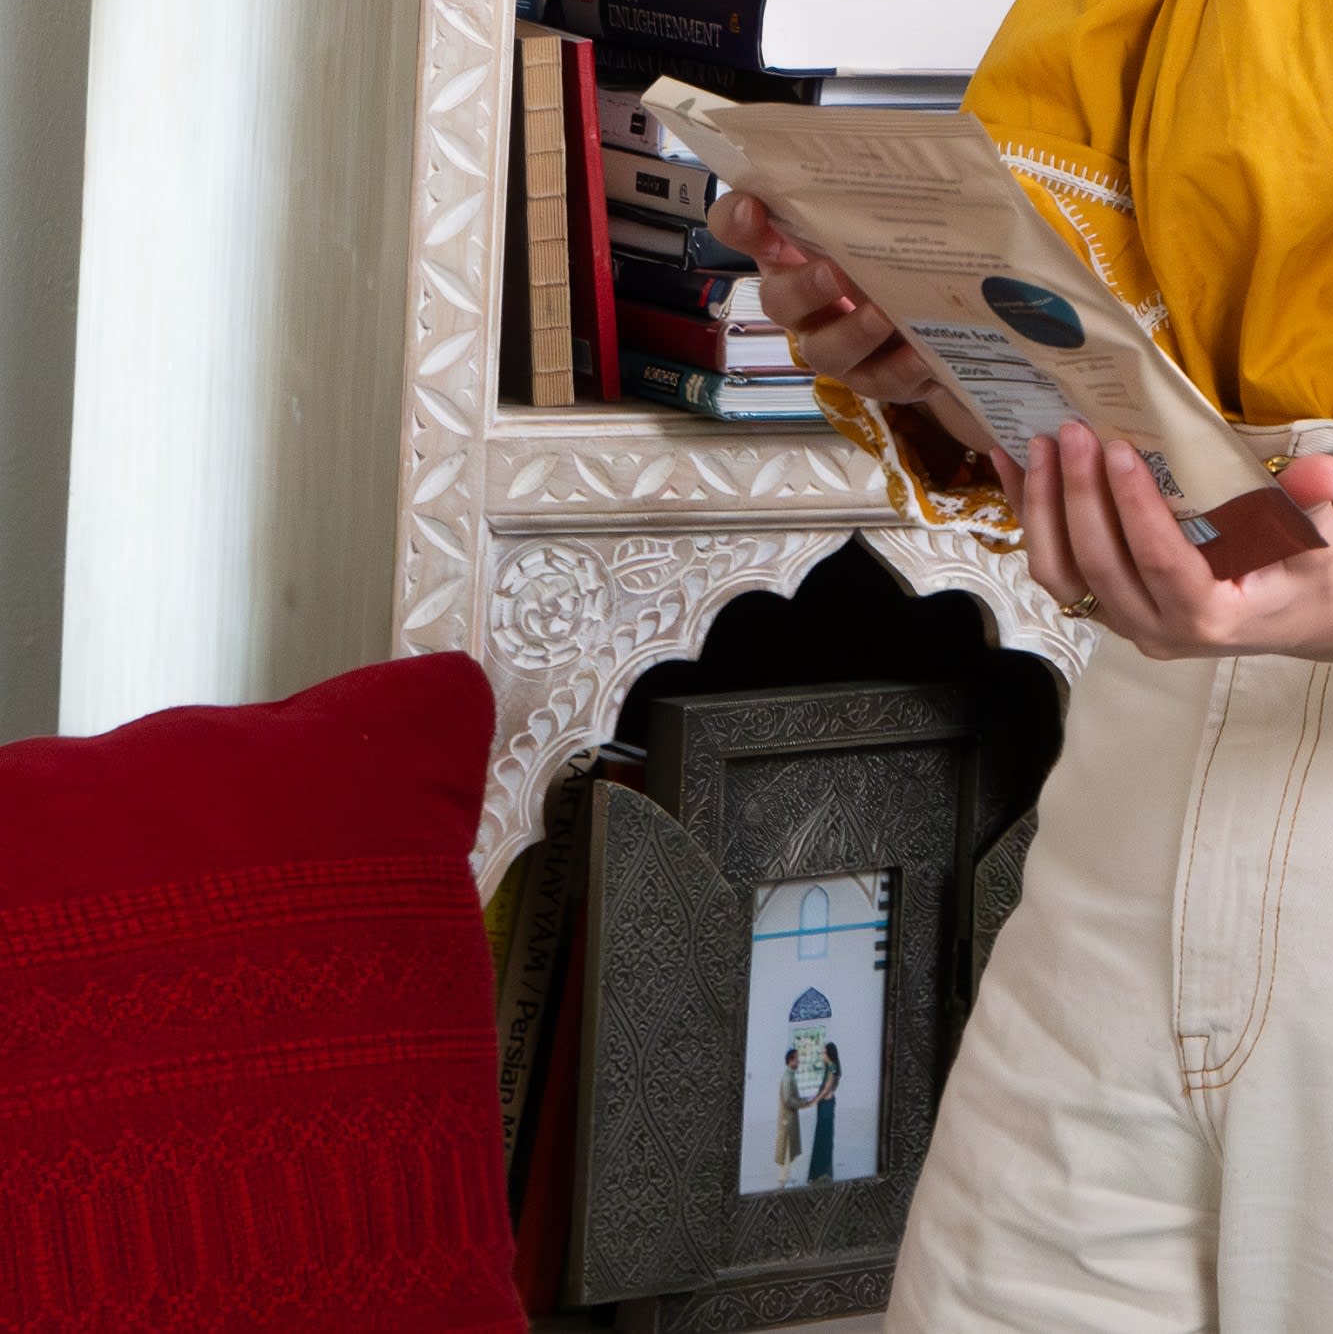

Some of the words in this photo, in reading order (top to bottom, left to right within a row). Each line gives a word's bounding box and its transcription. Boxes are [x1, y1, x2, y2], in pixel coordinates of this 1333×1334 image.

[608, 2, 723, 48] ENLIGHTENMENT
[524, 818, 572, 972] KHAYYAM
[500, 999, 540, 1104] Persian
